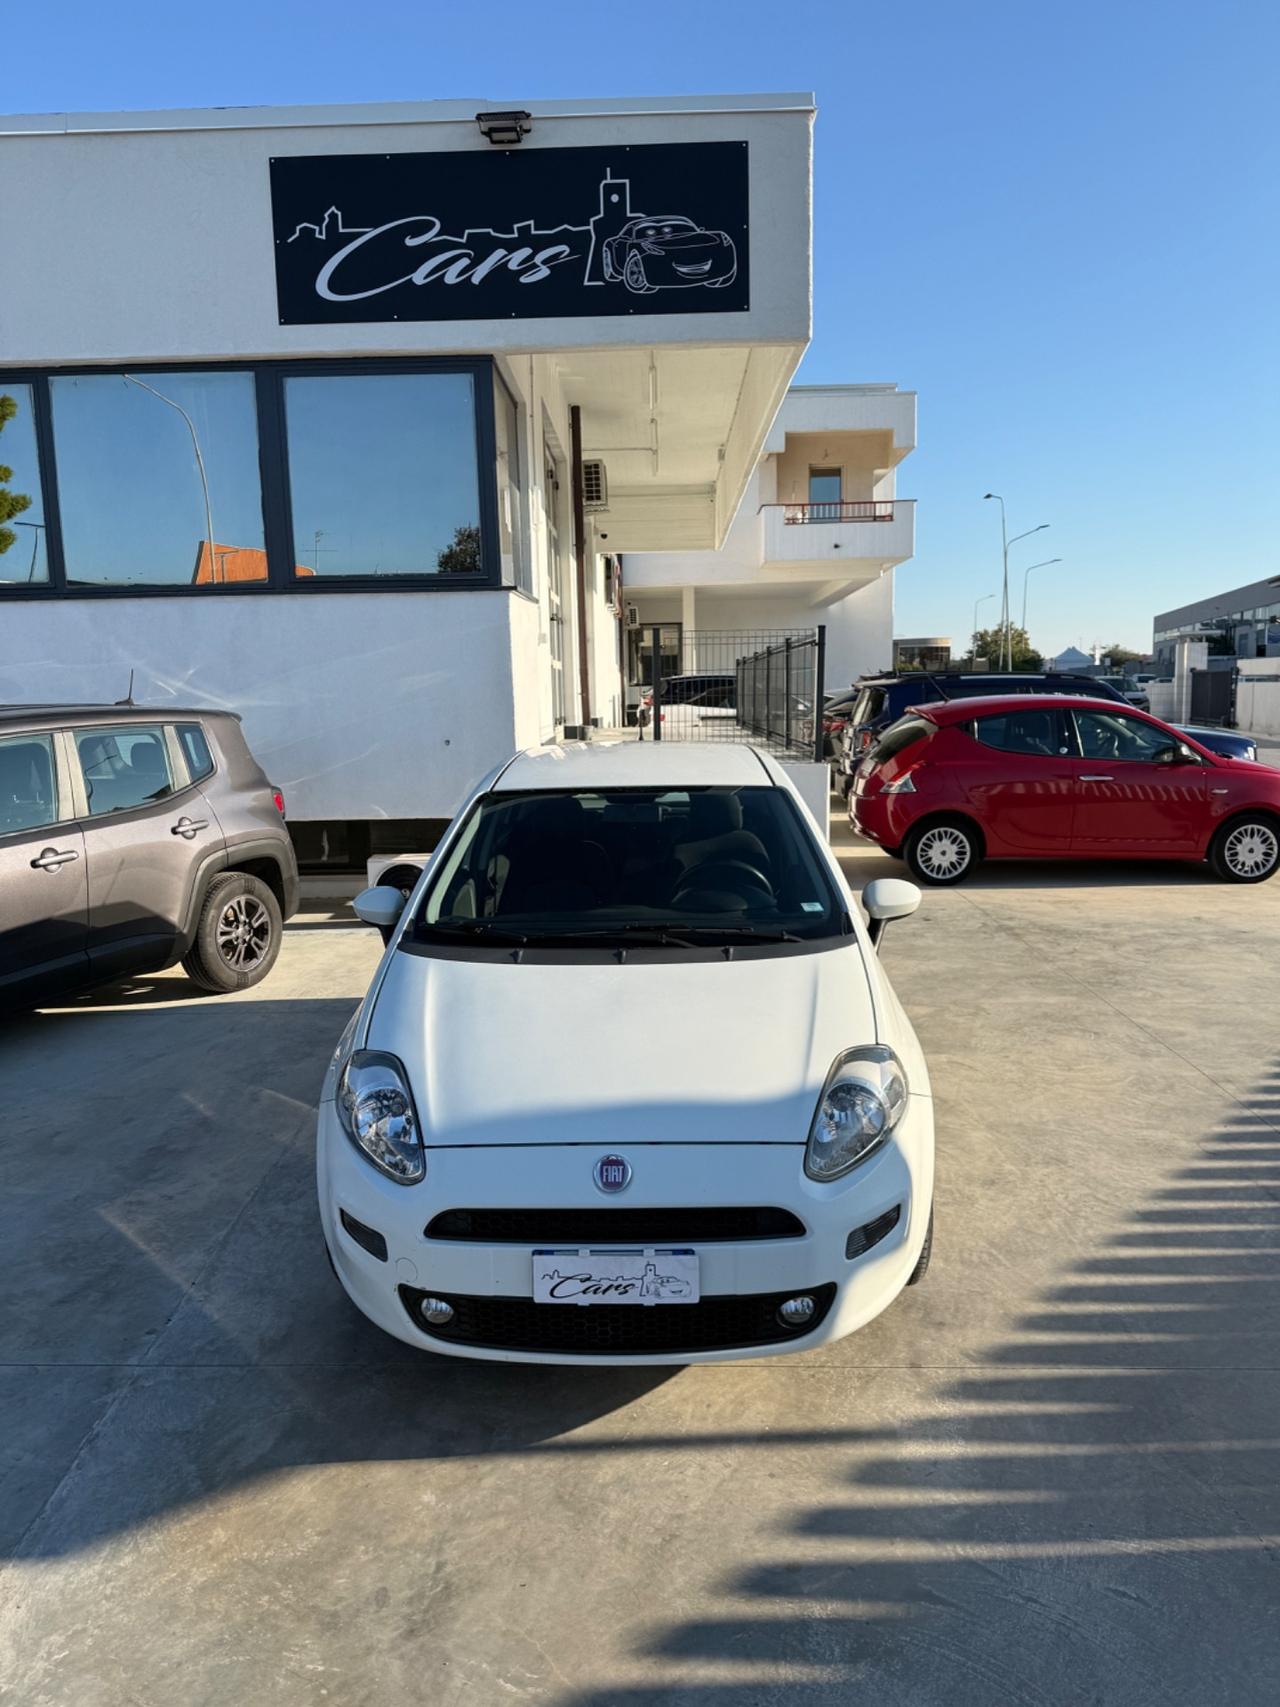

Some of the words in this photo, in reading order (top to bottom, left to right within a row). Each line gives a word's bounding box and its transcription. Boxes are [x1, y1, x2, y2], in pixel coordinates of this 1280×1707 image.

[315, 216, 581, 302] Cars
[602, 1165, 624, 1183] FIAT
[549, 1273, 637, 1299] Cars
